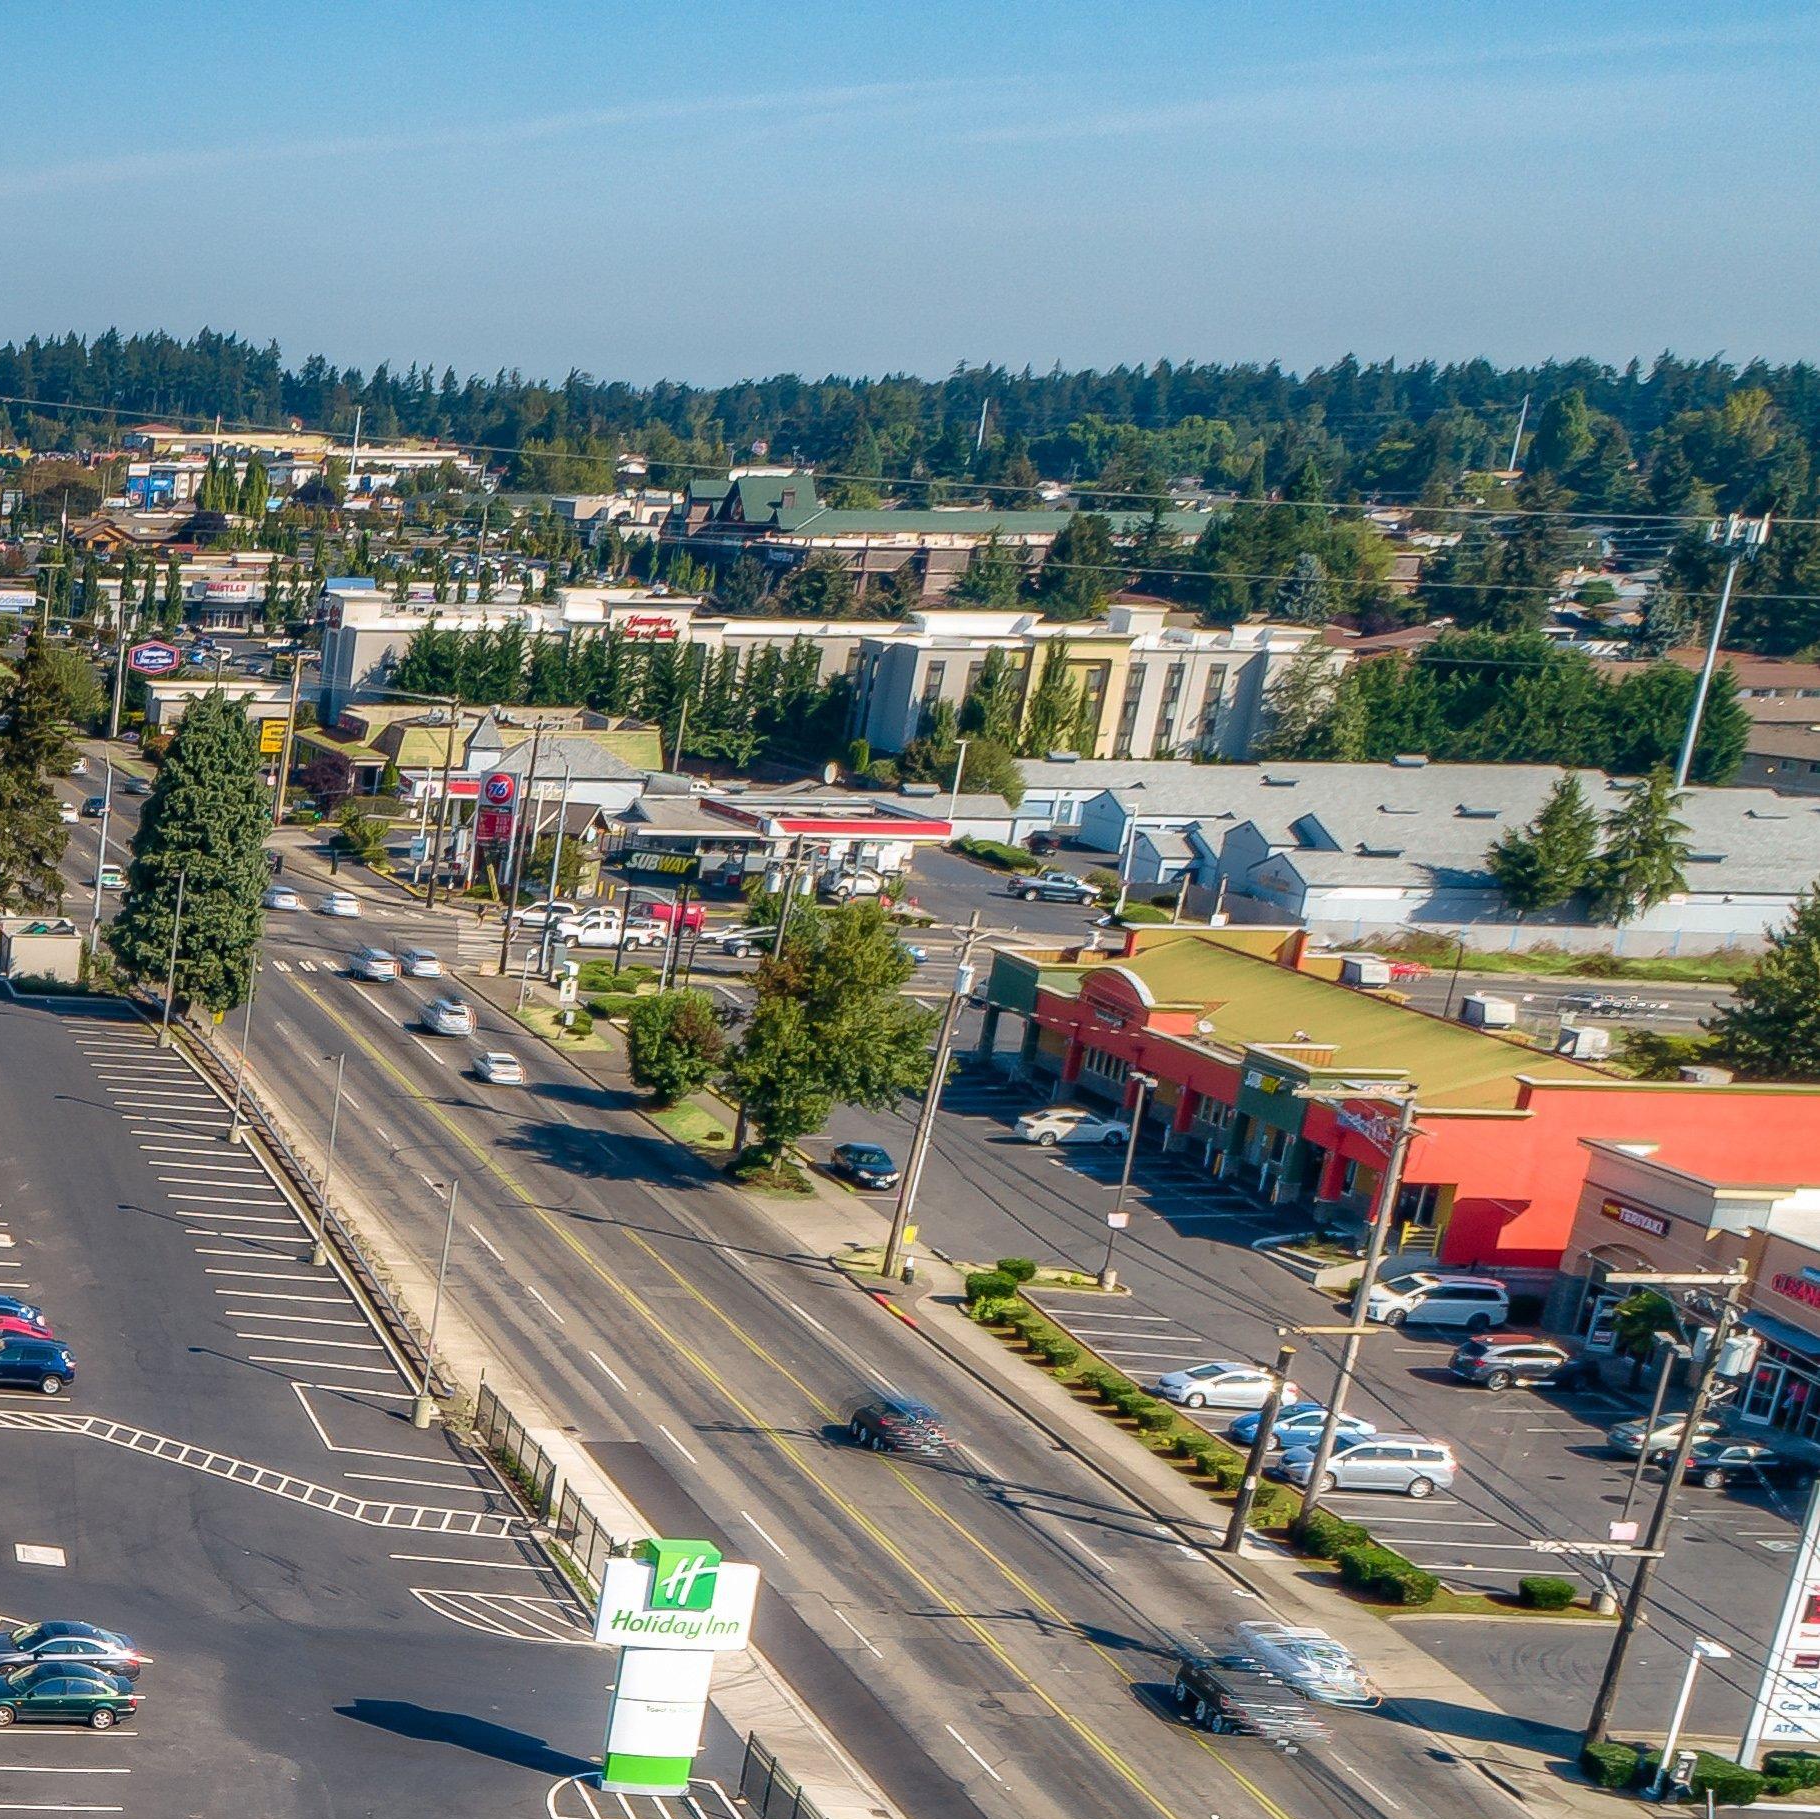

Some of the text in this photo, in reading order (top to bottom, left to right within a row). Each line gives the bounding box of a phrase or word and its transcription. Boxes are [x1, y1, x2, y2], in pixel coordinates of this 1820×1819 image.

[488, 782, 510, 798] 76
[625, 852, 697, 873] SUBWAY
[611, 1609, 740, 1639] Holiday Inn
